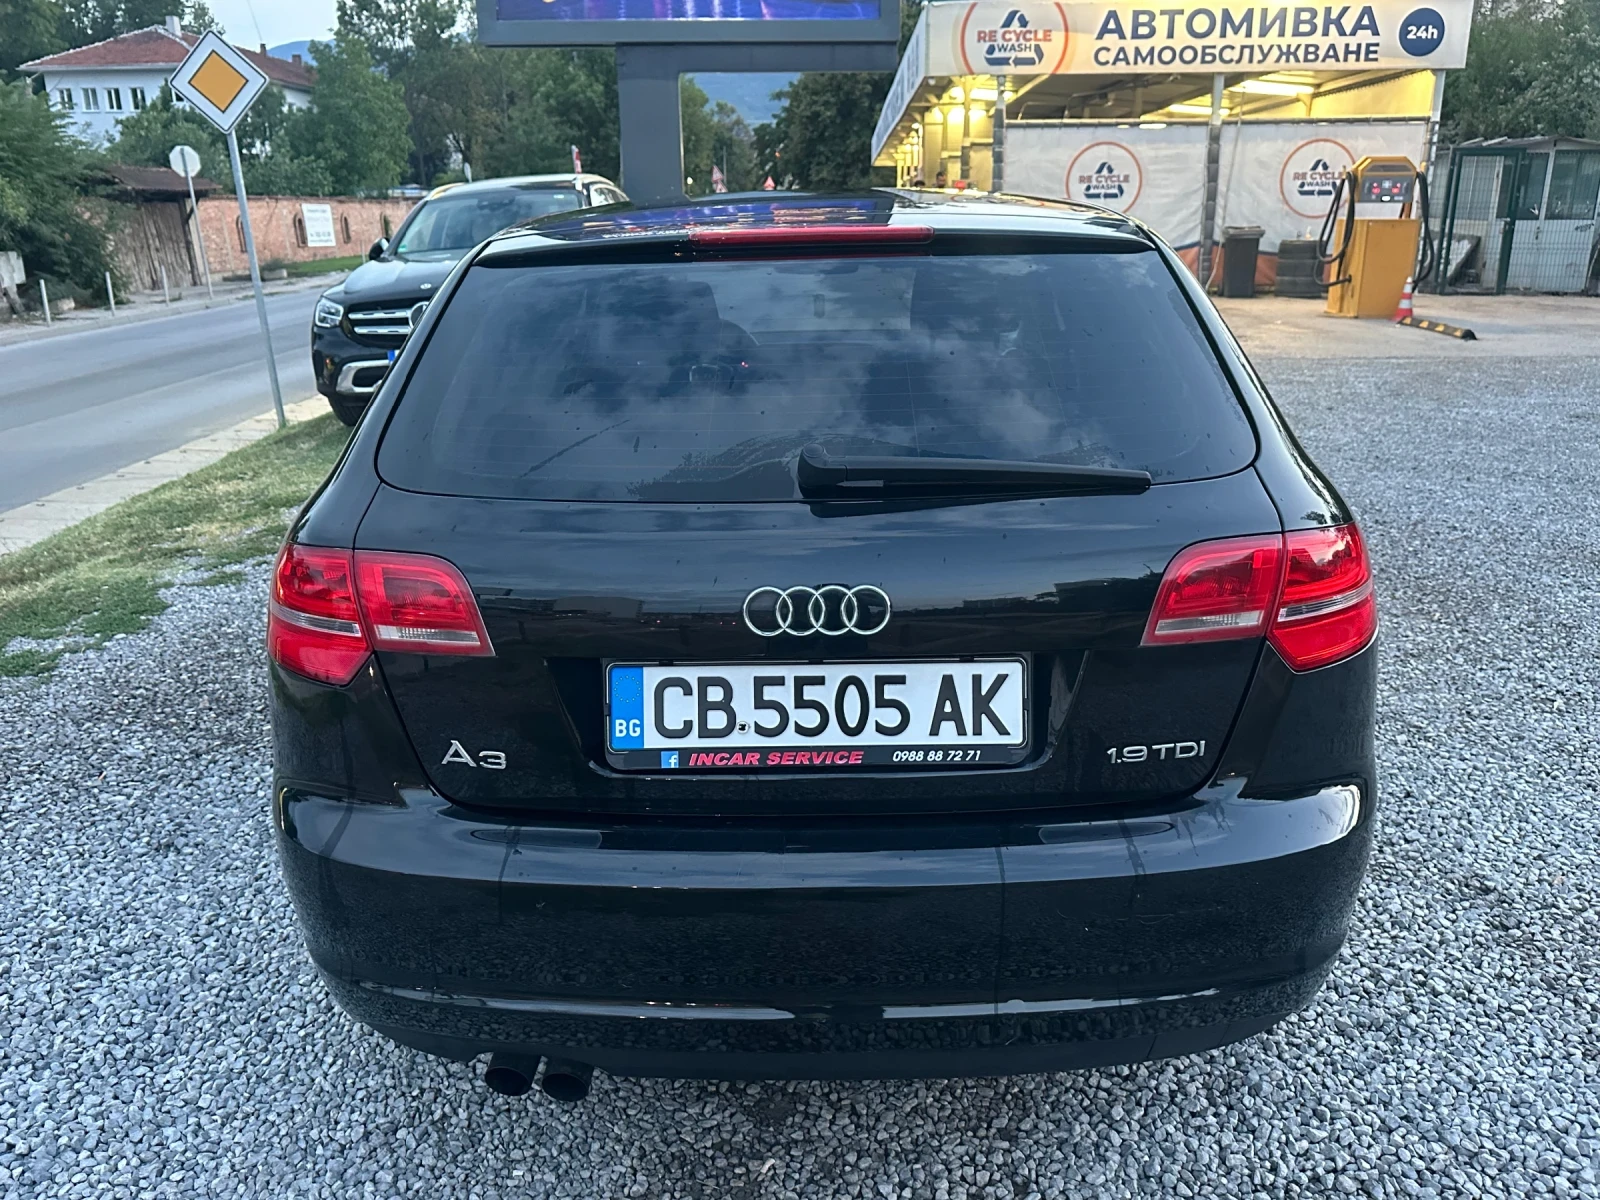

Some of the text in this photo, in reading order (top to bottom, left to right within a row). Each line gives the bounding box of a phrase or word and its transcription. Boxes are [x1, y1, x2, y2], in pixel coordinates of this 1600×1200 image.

[1095, 6, 1380, 40] АВТОМИВКА
[977, 29, 1052, 43] RE CYCLE
[1406, 25, 1438, 39] 24h
[997, 43, 1032, 53] WASH
[1094, 42, 1380, 66] САМООБСЛУЖВАНЕ
[1078, 174, 1130, 184] RE CYCLE
[1293, 172, 1307, 180] RE
[654, 673, 1011, 739] CB 5505 AK
[615, 719, 641, 737] BG
[441, 739, 507, 770] A3
[689, 751, 864, 766] INCAR SERVICE
[892, 750, 981, 762] 0988 88 72 71
[1106, 740, 1206, 764] 1.9 TDI
